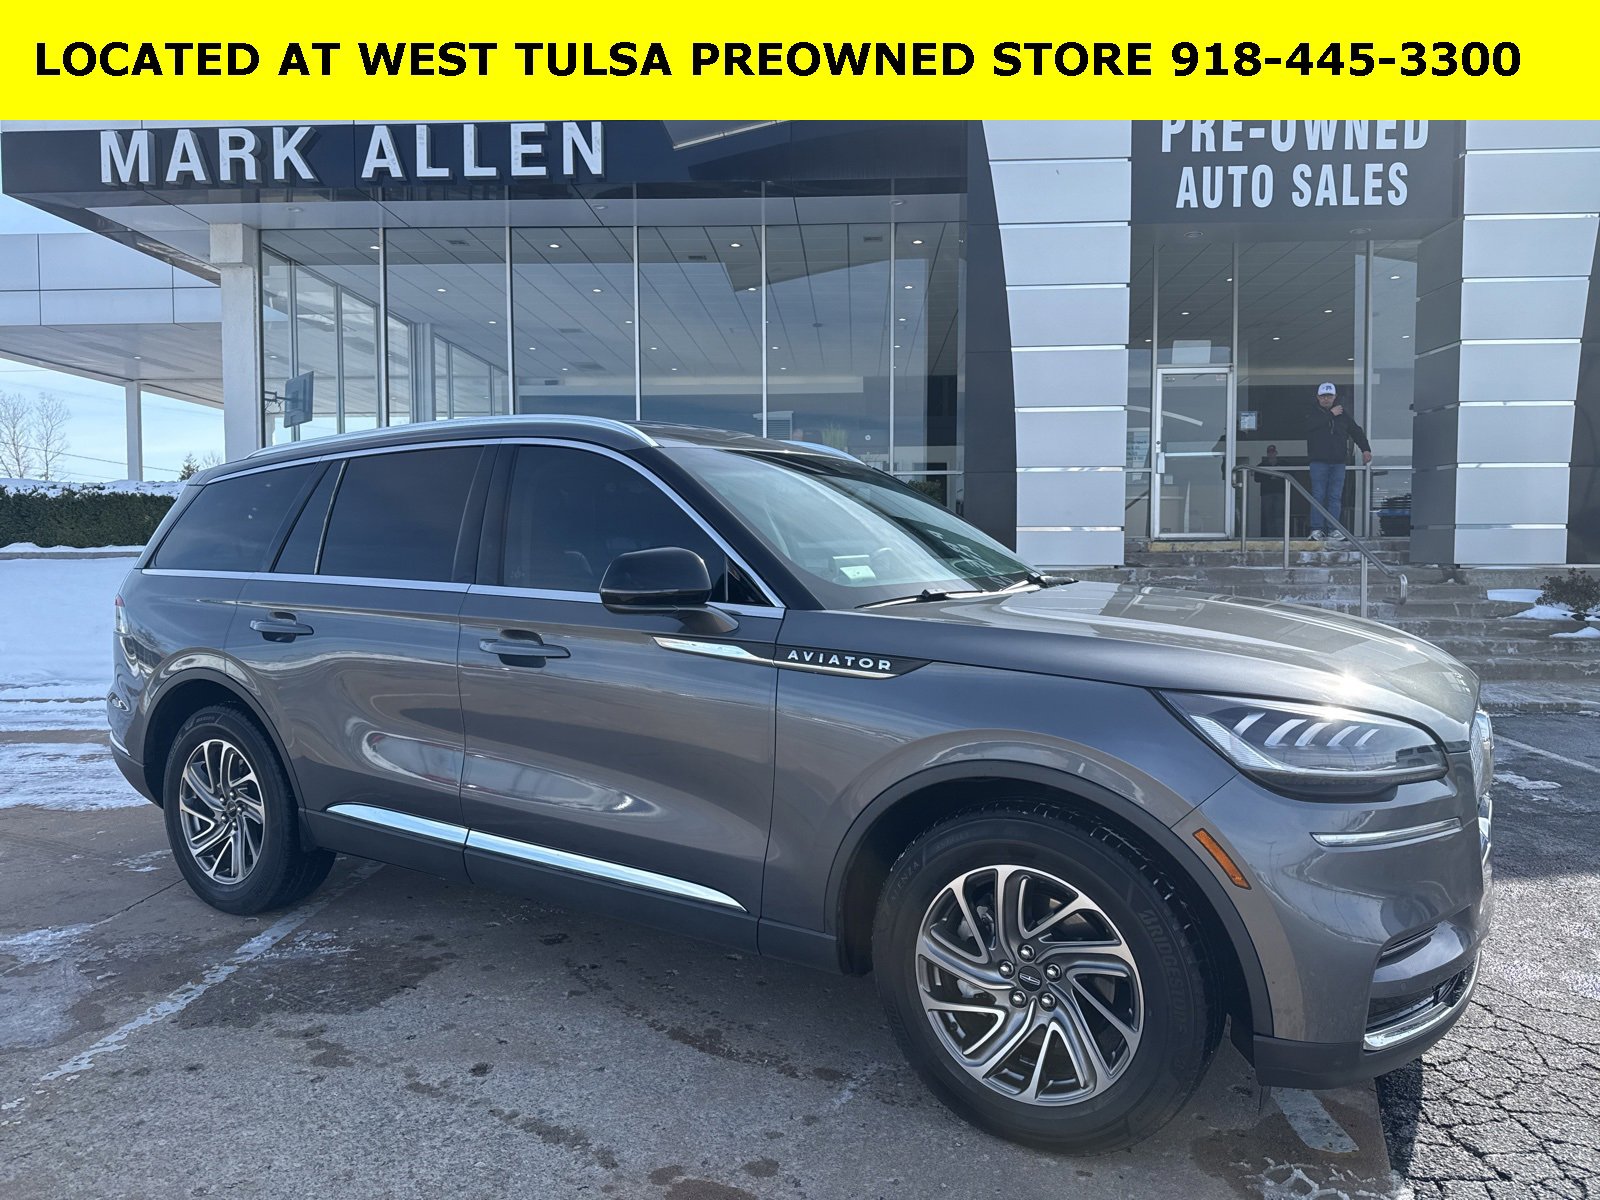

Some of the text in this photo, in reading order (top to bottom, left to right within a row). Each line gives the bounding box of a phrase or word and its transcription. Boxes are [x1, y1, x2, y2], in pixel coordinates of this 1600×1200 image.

[100, 121, 604, 183] MARK ALLEN
[1161, 120, 1429, 153] PRE-OWNED
[1175, 161, 1409, 209] AUTO SALES
[787, 649, 892, 671] AVIATOR
